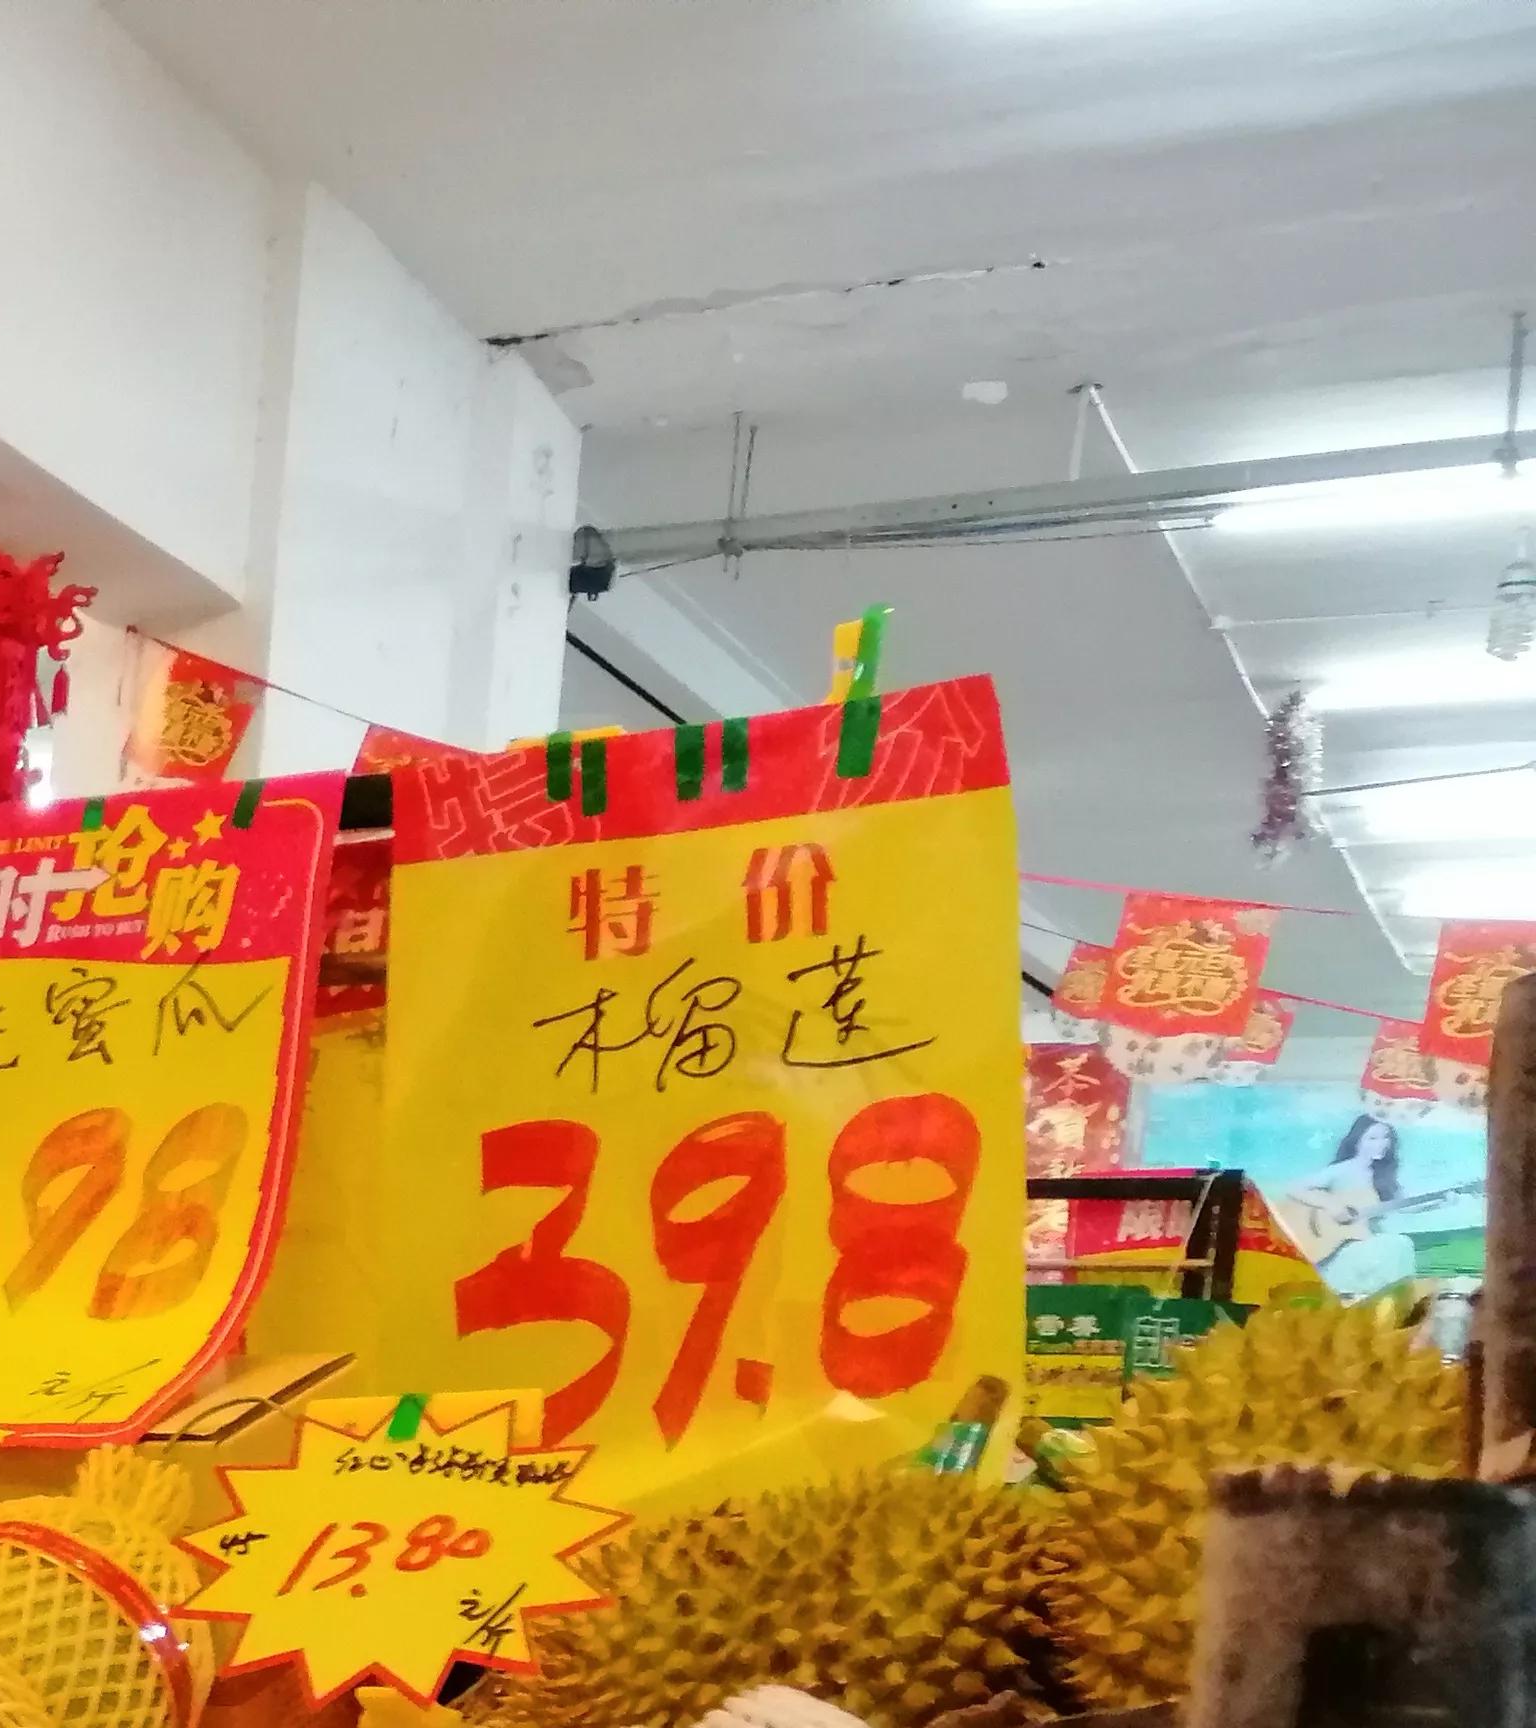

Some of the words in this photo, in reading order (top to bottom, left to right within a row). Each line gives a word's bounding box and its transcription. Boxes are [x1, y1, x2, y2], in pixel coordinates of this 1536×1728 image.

[566, 842, 837, 961] 特价
[454, 1092, 982, 1453] 39.8
[275, 1513, 495, 1600] 13.80
